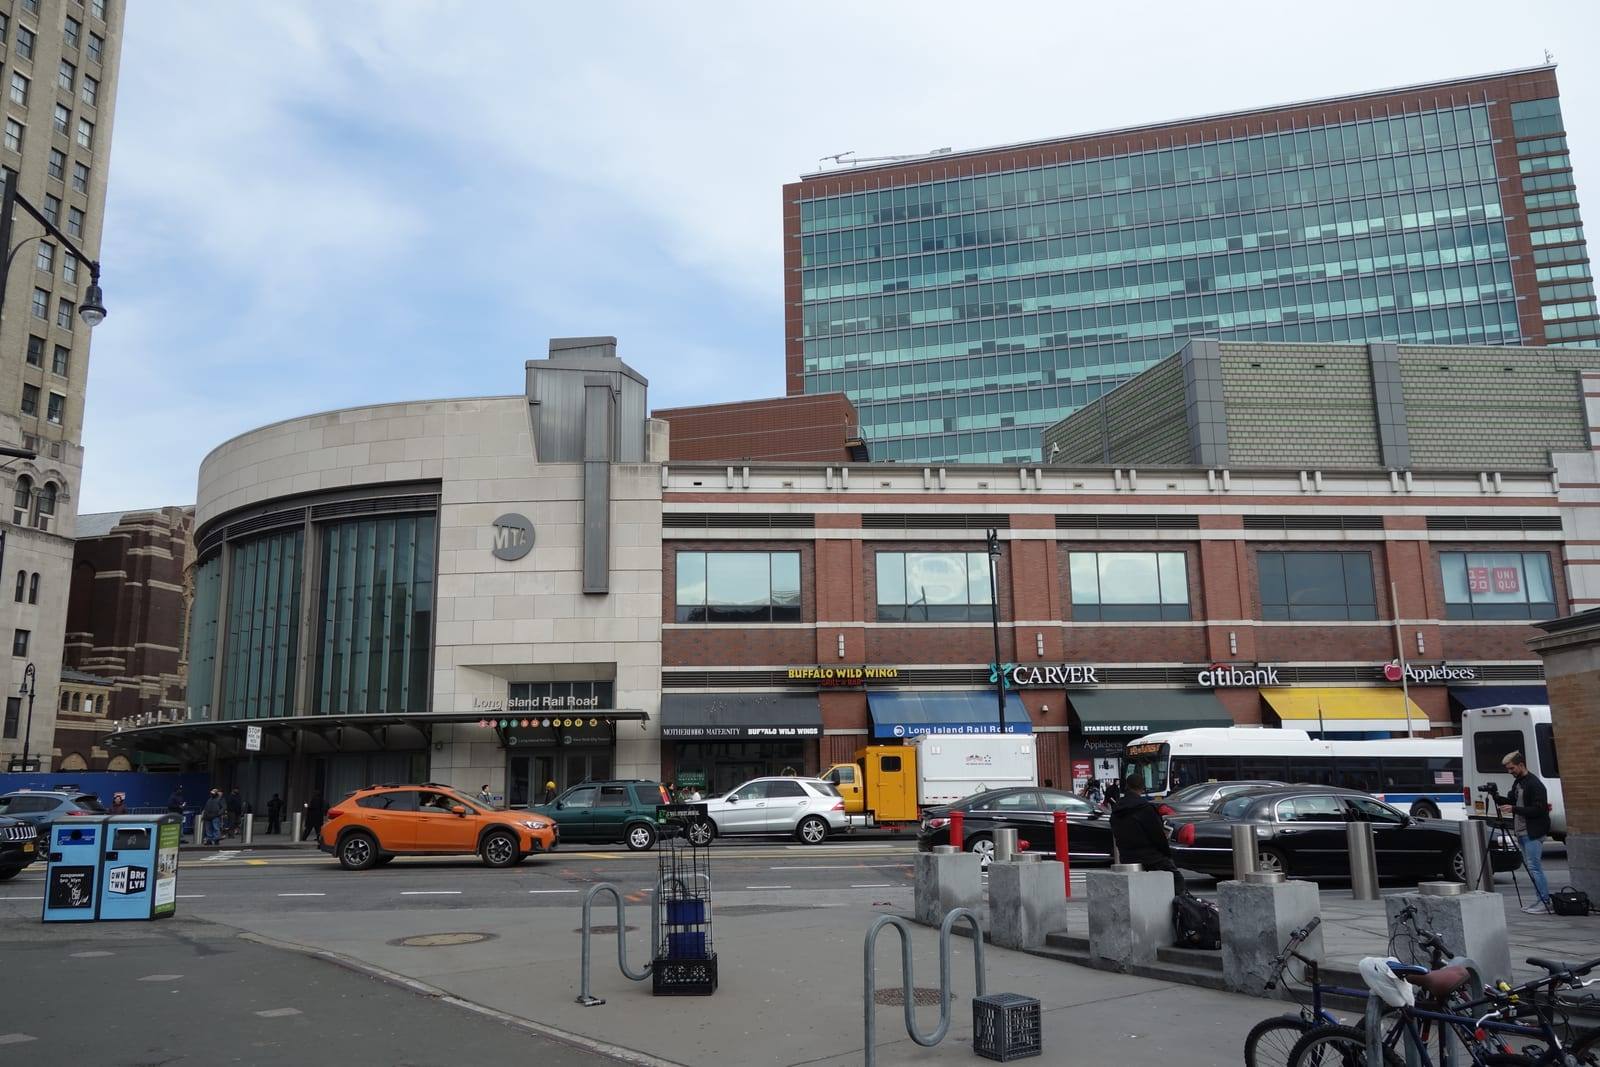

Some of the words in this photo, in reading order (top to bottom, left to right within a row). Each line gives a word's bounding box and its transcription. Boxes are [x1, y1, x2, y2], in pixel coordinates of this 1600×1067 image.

[491, 525, 526, 549] MTA
[788, 668, 833, 679] BUFFALO
[836, 668, 862, 679] WILD
[865, 668, 898, 678] WINGS
[1013, 665, 1099, 684] CARVER
[1197, 665, 1280, 686] citibank
[473, 697, 503, 709] Long
[505, 696, 540, 708] Island
[542, 696, 564, 707] Rail
[567, 695, 598, 706] Road
[706, 728, 741, 736] MATERNITY
[908, 726, 931, 735] Long
[933, 725, 964, 734] Island
[966, 725, 987, 733] Rail
[130, 870, 146, 880] BRK
[111, 880, 125, 889] TWN
[129, 880, 145, 890] LYN
